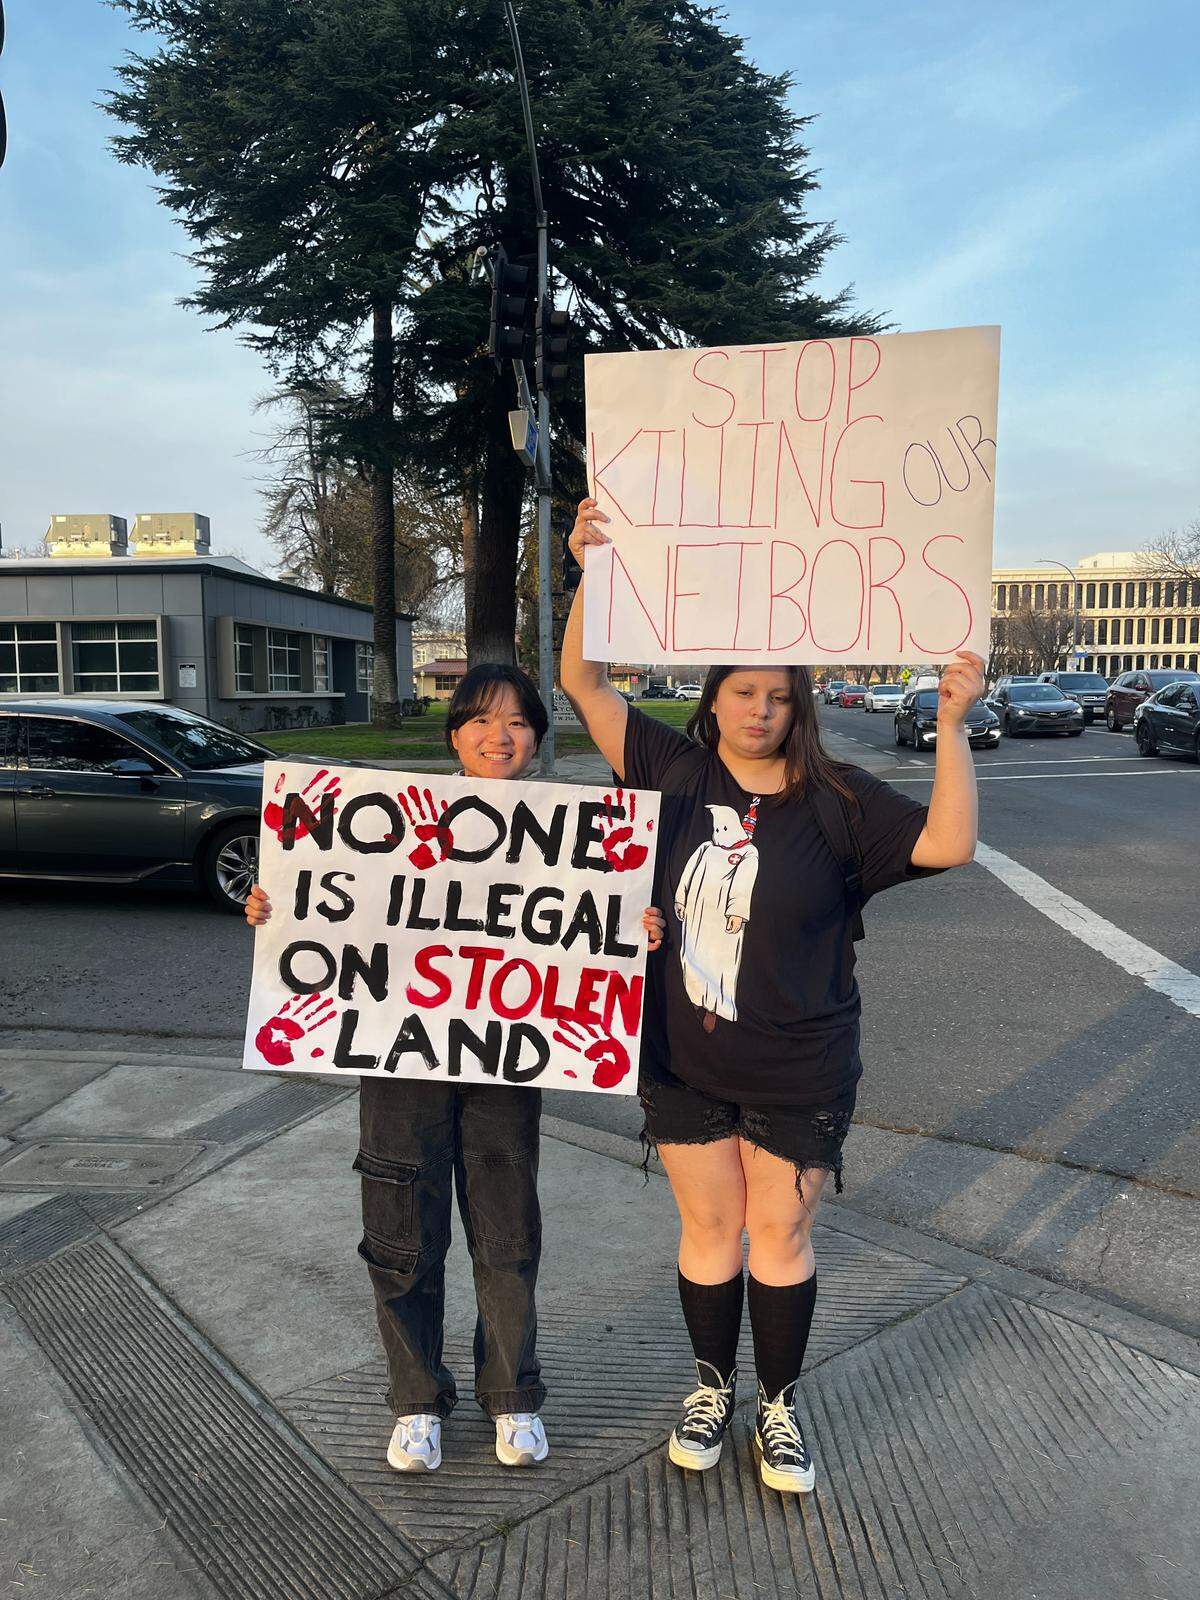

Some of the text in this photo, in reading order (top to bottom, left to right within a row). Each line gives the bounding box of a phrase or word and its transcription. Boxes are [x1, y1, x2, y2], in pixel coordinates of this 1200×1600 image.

[692, 337, 881, 428] STOP
[591, 414, 997, 530] KILLING OUR
[608, 535, 972, 655] NEIBORS
[281, 792, 626, 873] NO ONE
[294, 870, 639, 959] IS ILLEGAL
[279, 940, 644, 1036] ON STOLEN
[332, 1009, 551, 1083] LAND
